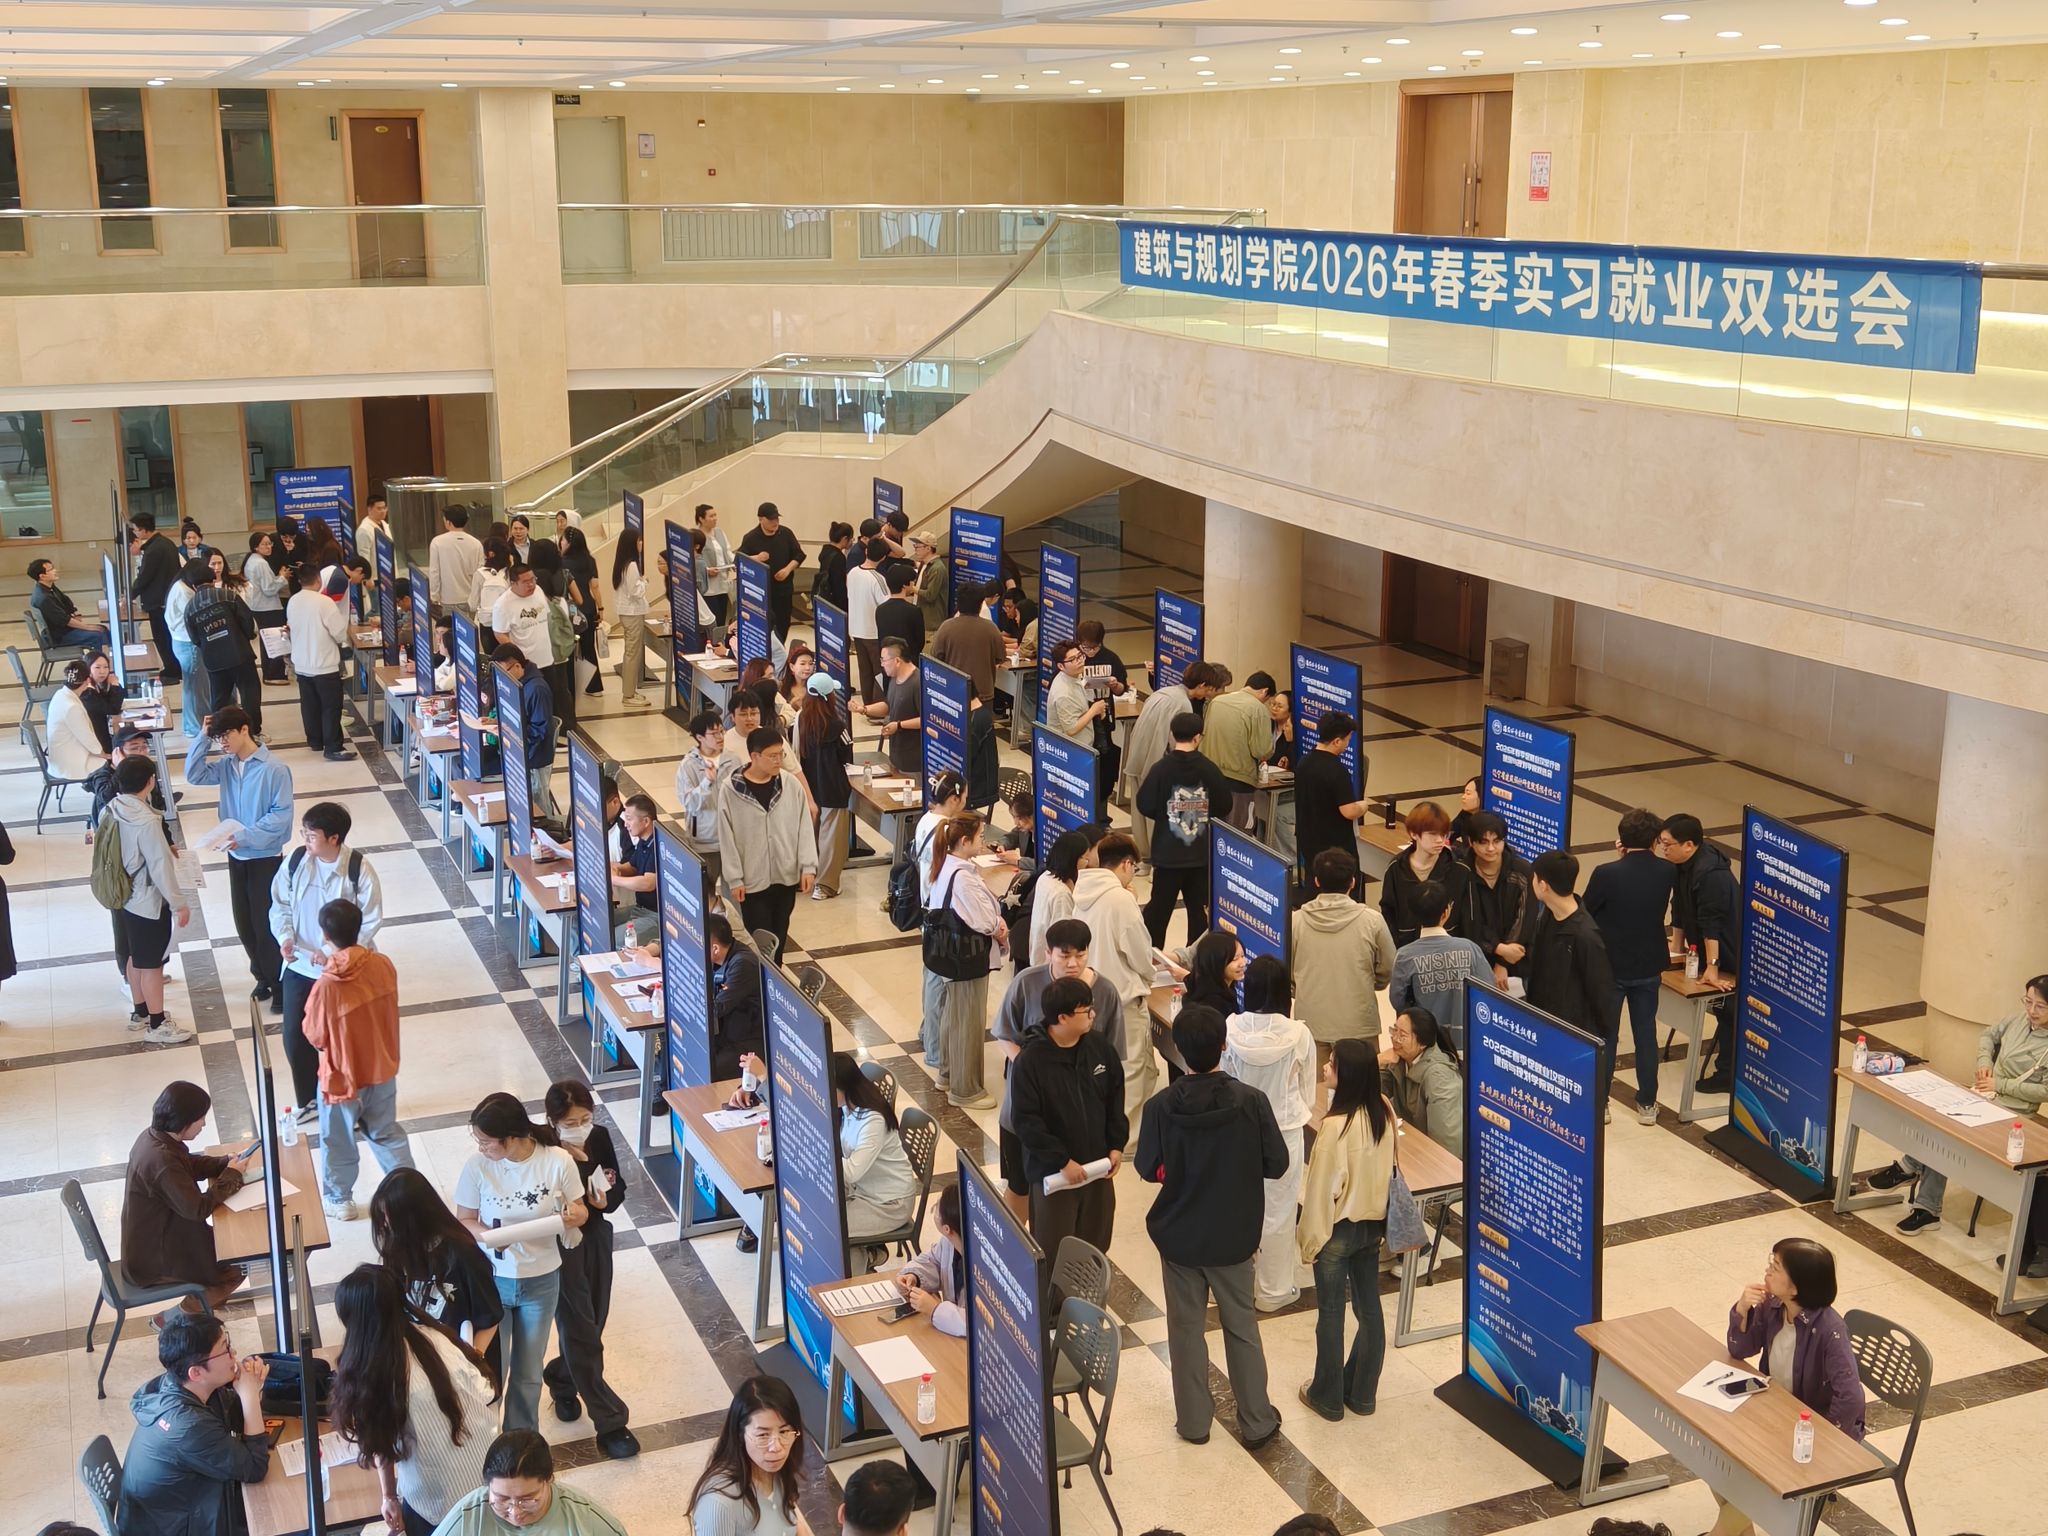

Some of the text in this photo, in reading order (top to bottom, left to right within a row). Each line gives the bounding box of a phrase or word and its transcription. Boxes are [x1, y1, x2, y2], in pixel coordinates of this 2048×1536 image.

[1133, 230, 1912, 350] 建筑与规划学院2026年春季实习就业双选会
[1414, 951, 1471, 972] WSNH
